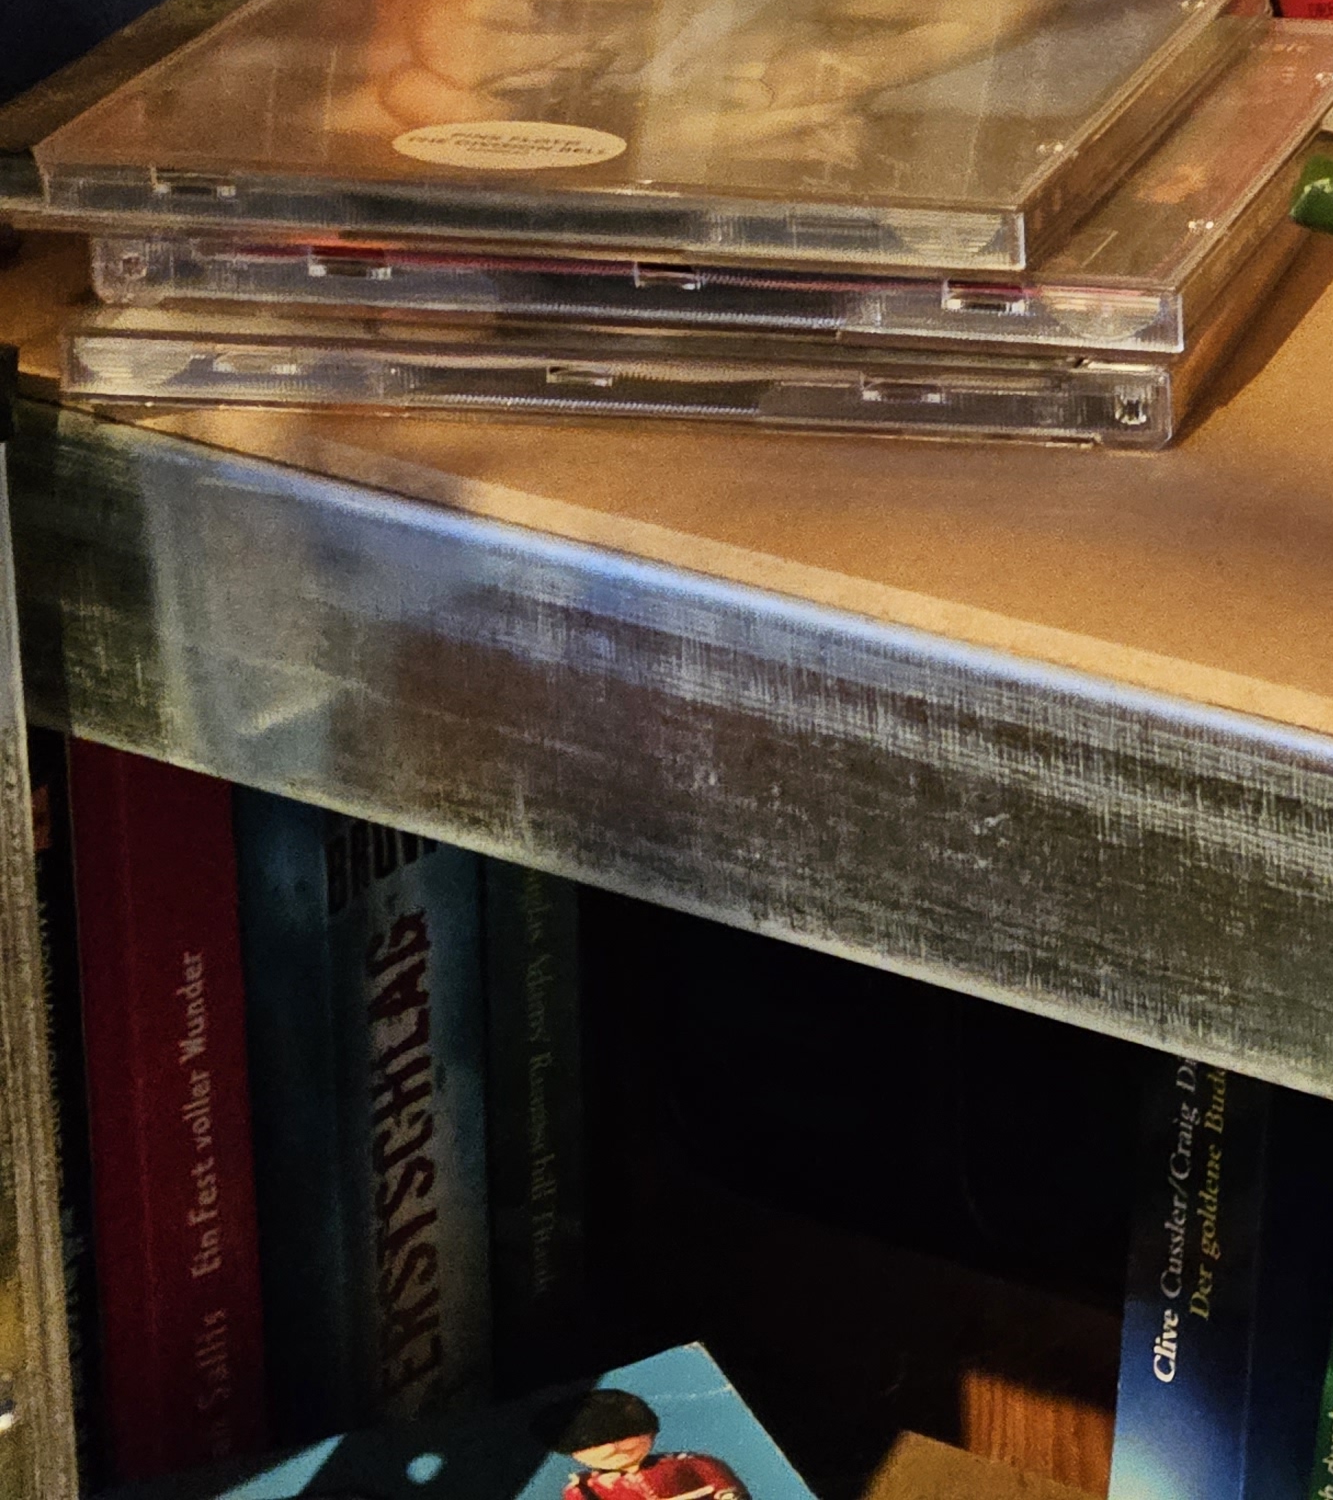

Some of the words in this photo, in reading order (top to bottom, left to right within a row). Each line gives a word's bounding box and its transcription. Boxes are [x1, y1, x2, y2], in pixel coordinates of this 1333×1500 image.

[177, 950, 208, 1065] Wunder
[185, 1069, 214, 1150] voller
[187, 1156, 219, 1221] Fest
[364, 908, 442, 1397] ERSTSCHLAG
[1197, 1144, 1223, 1262] goldene
[190, 1229, 223, 1279] Ein
[1189, 1262, 1214, 1322] Der
[1152, 1309, 1180, 1384] Clive
